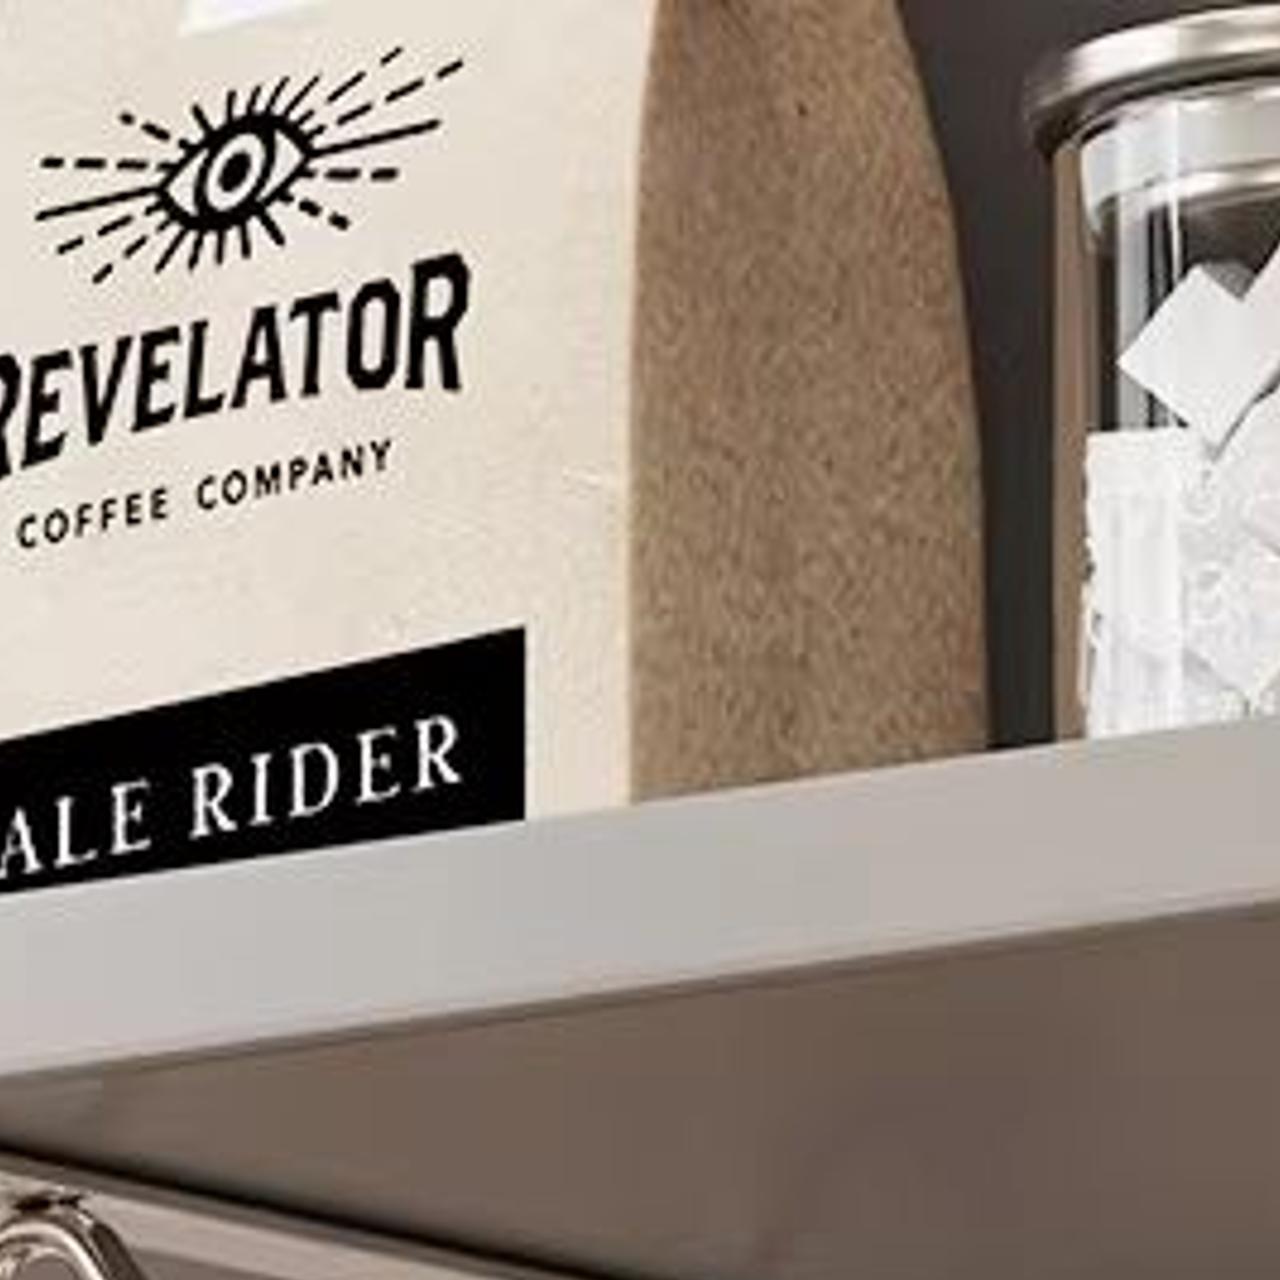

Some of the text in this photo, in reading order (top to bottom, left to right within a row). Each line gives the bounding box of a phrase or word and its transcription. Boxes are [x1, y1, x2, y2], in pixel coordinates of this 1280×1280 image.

[15, 439, 393, 549] COFFEE COMPANY
[190, 713, 463, 839] RIDER
